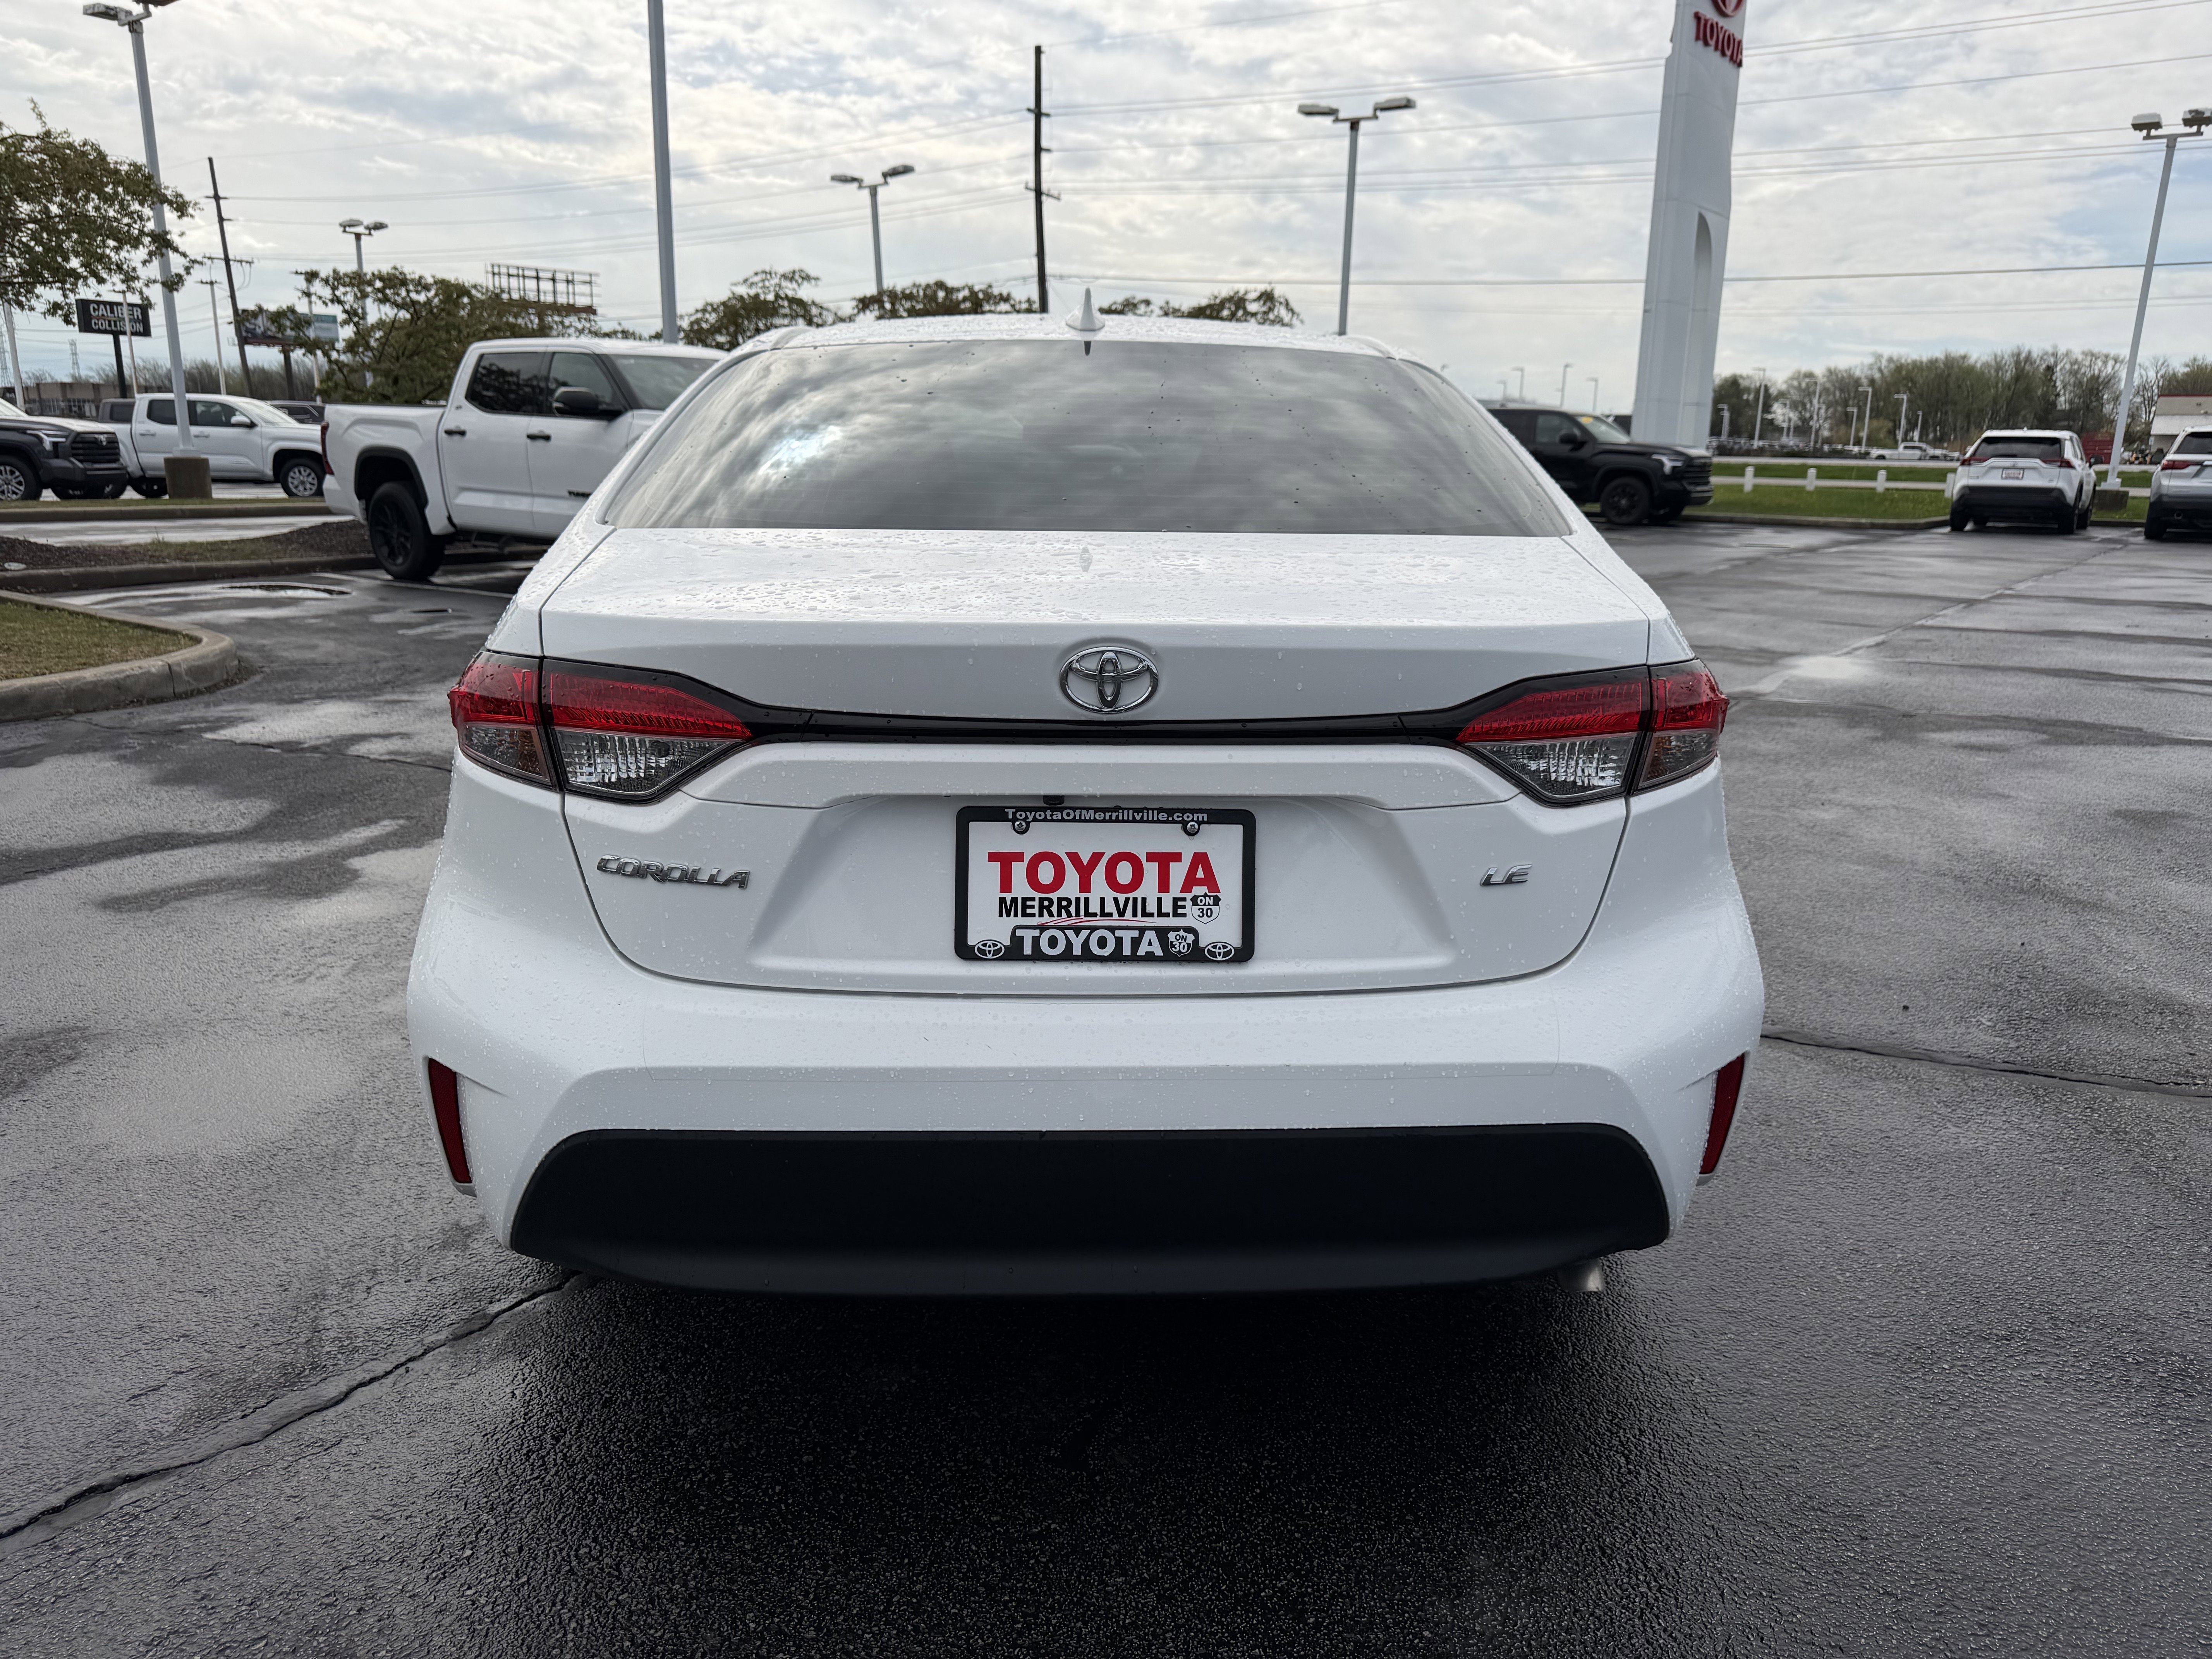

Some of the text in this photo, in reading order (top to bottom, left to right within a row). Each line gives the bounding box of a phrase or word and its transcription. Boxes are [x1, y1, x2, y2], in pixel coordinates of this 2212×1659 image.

[90, 303, 142, 320] CALIBER
[91, 318, 144, 333] COLLISON
[1005, 809, 1207, 822] ToyotaOfMerrillville.com
[597, 854, 750, 889] COROLLA
[988, 851, 1221, 893] TOYOTA
[1479, 864, 1532, 886] LE
[998, 896, 1187, 918] MERRILLVILLE
[1197, 896, 1213, 905] ON
[1197, 907, 1213, 918] 30
[1016, 929, 1164, 956] TOYOTA
[1175, 934, 1187, 942] ON
[1172, 941, 1188, 953] 30
